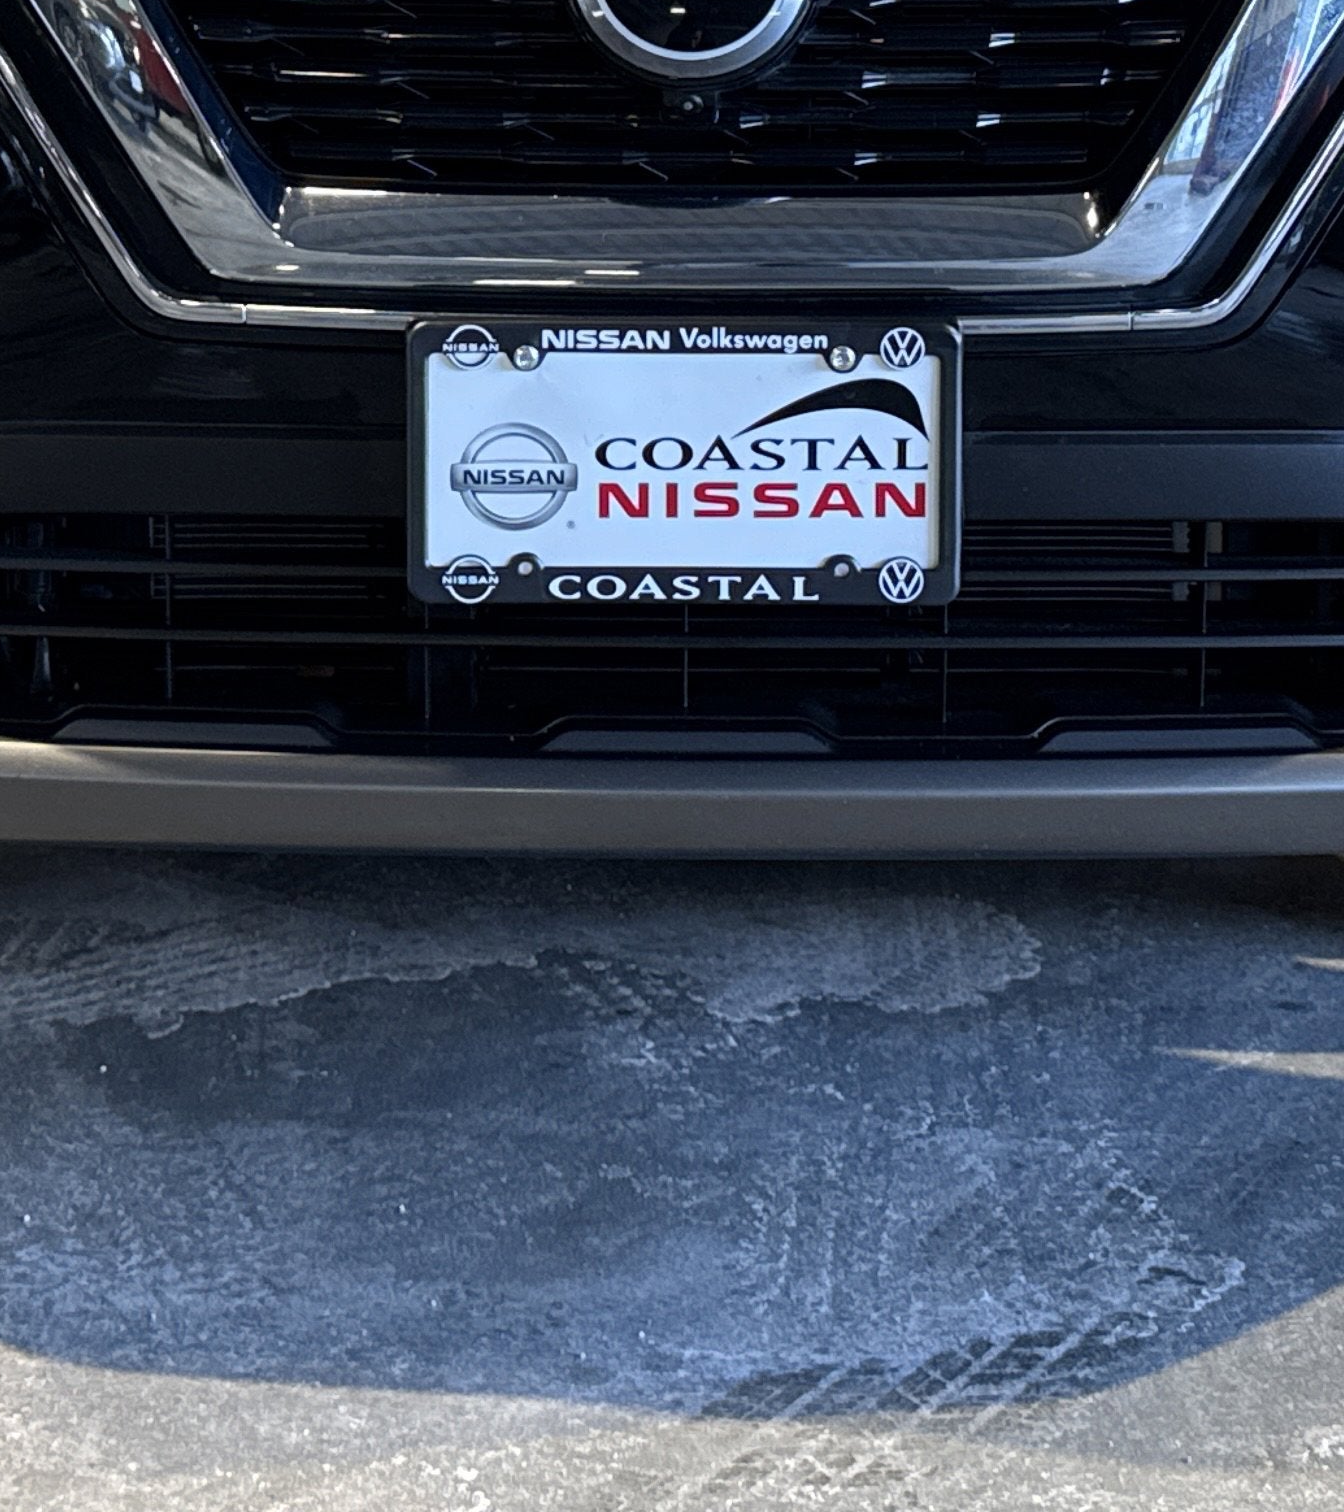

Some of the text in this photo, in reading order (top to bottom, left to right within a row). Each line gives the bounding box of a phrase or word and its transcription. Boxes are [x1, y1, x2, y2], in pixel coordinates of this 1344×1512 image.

[442, 341, 500, 353] NISSAN
[541, 326, 829, 354] NISSAN Volkswagen
[594, 433, 930, 472] COASTAL
[463, 469, 565, 486] NISSAN
[597, 481, 927, 519] NISSAN
[441, 574, 500, 586] NISSAN
[547, 573, 820, 602] COASTAL
